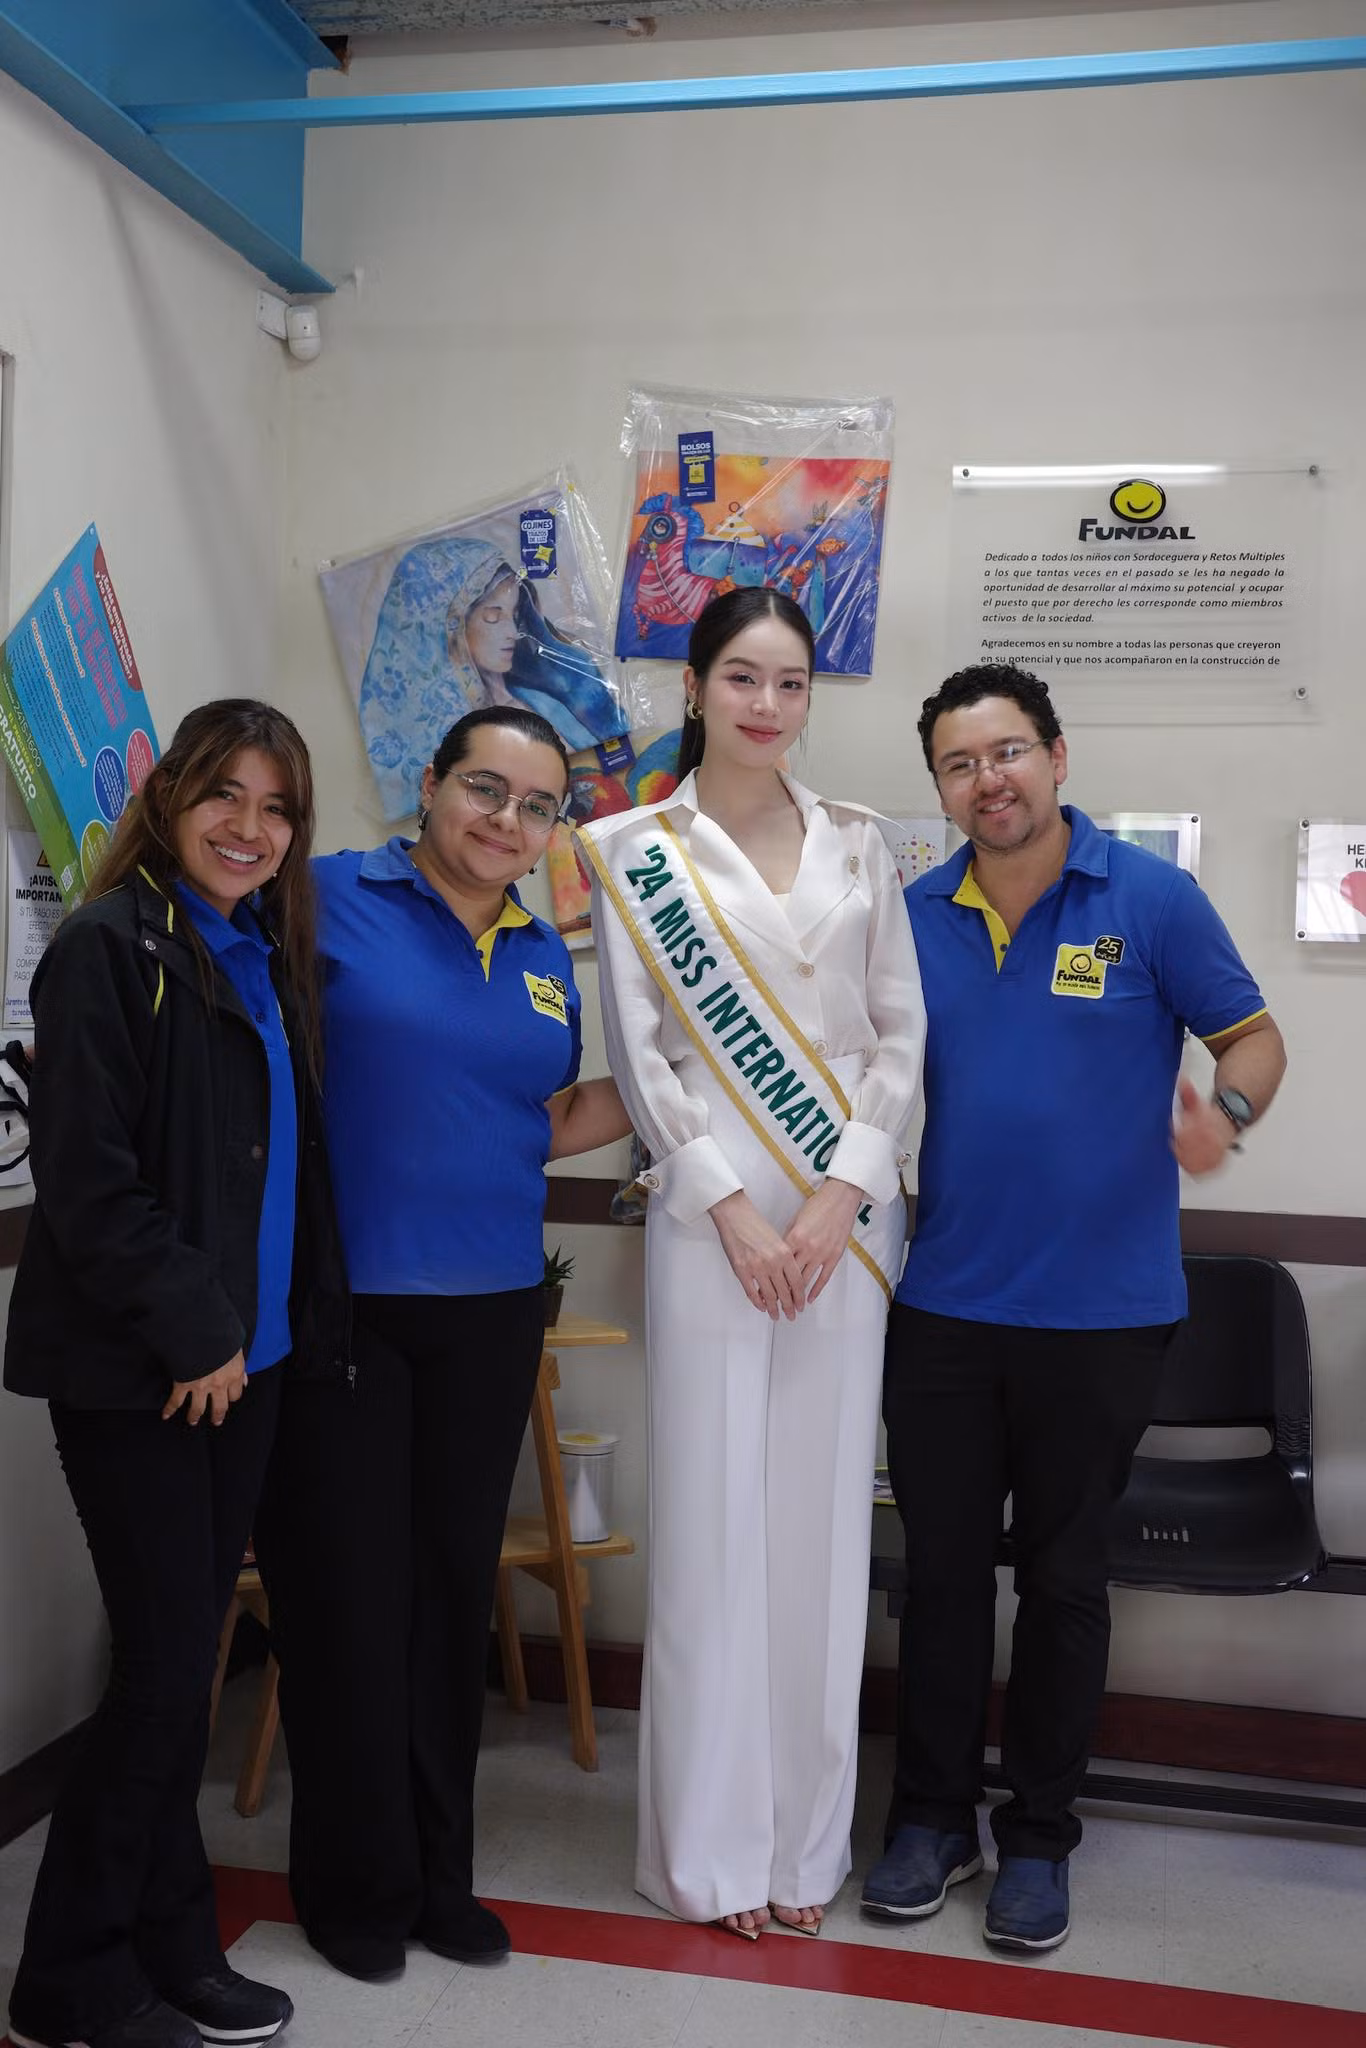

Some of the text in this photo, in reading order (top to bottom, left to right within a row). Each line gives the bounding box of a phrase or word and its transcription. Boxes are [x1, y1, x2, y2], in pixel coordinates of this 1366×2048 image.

[680, 442, 711, 451] BOLSOS
[522, 520, 552, 530] COJINES
[1078, 518, 1196, 542] FUNDAL
[984, 551, 1285, 564] Dedicado a todos los niños con Sordoceguera y Retos Múltiples
[984, 569, 991, 577] a
[994, 568, 1009, 577] los
[1013, 570, 1032, 579] que
[1036, 569, 1069, 577] tantas
[1122, 568, 1132, 577] el
[1135, 568, 1174, 579] pasado
[1178, 569, 1189, 577] se
[1193, 567, 1208, 577] les
[1212, 568, 1226, 577] ha
[1230, 567, 1270, 580] negado
[1274, 567, 1284, 577] la
[983, 582, 1284, 595] oportunidad de desarrollar al máximo su potencial y ocupar
[983, 597, 1283, 610] el puesto que por derecho les corresponde como miembros
[982, 613, 1095, 623] activos de la sociedad.
[981, 638, 1281, 651] Agradecemos en su nombre a todas las personas que creyeron
[980, 653, 1280, 668] en su potencial y que nos acompañaron en la construcción de
[13, 701, 42, 768] 2415-1600
[15, 889, 62, 902] IMPORTAN
[1098, 937, 1120, 954] 25
[1057, 970, 1101, 985] FUNDAL
[650, 897, 718, 988] MISS
[697, 981, 873, 1227] INTERNATIOL
